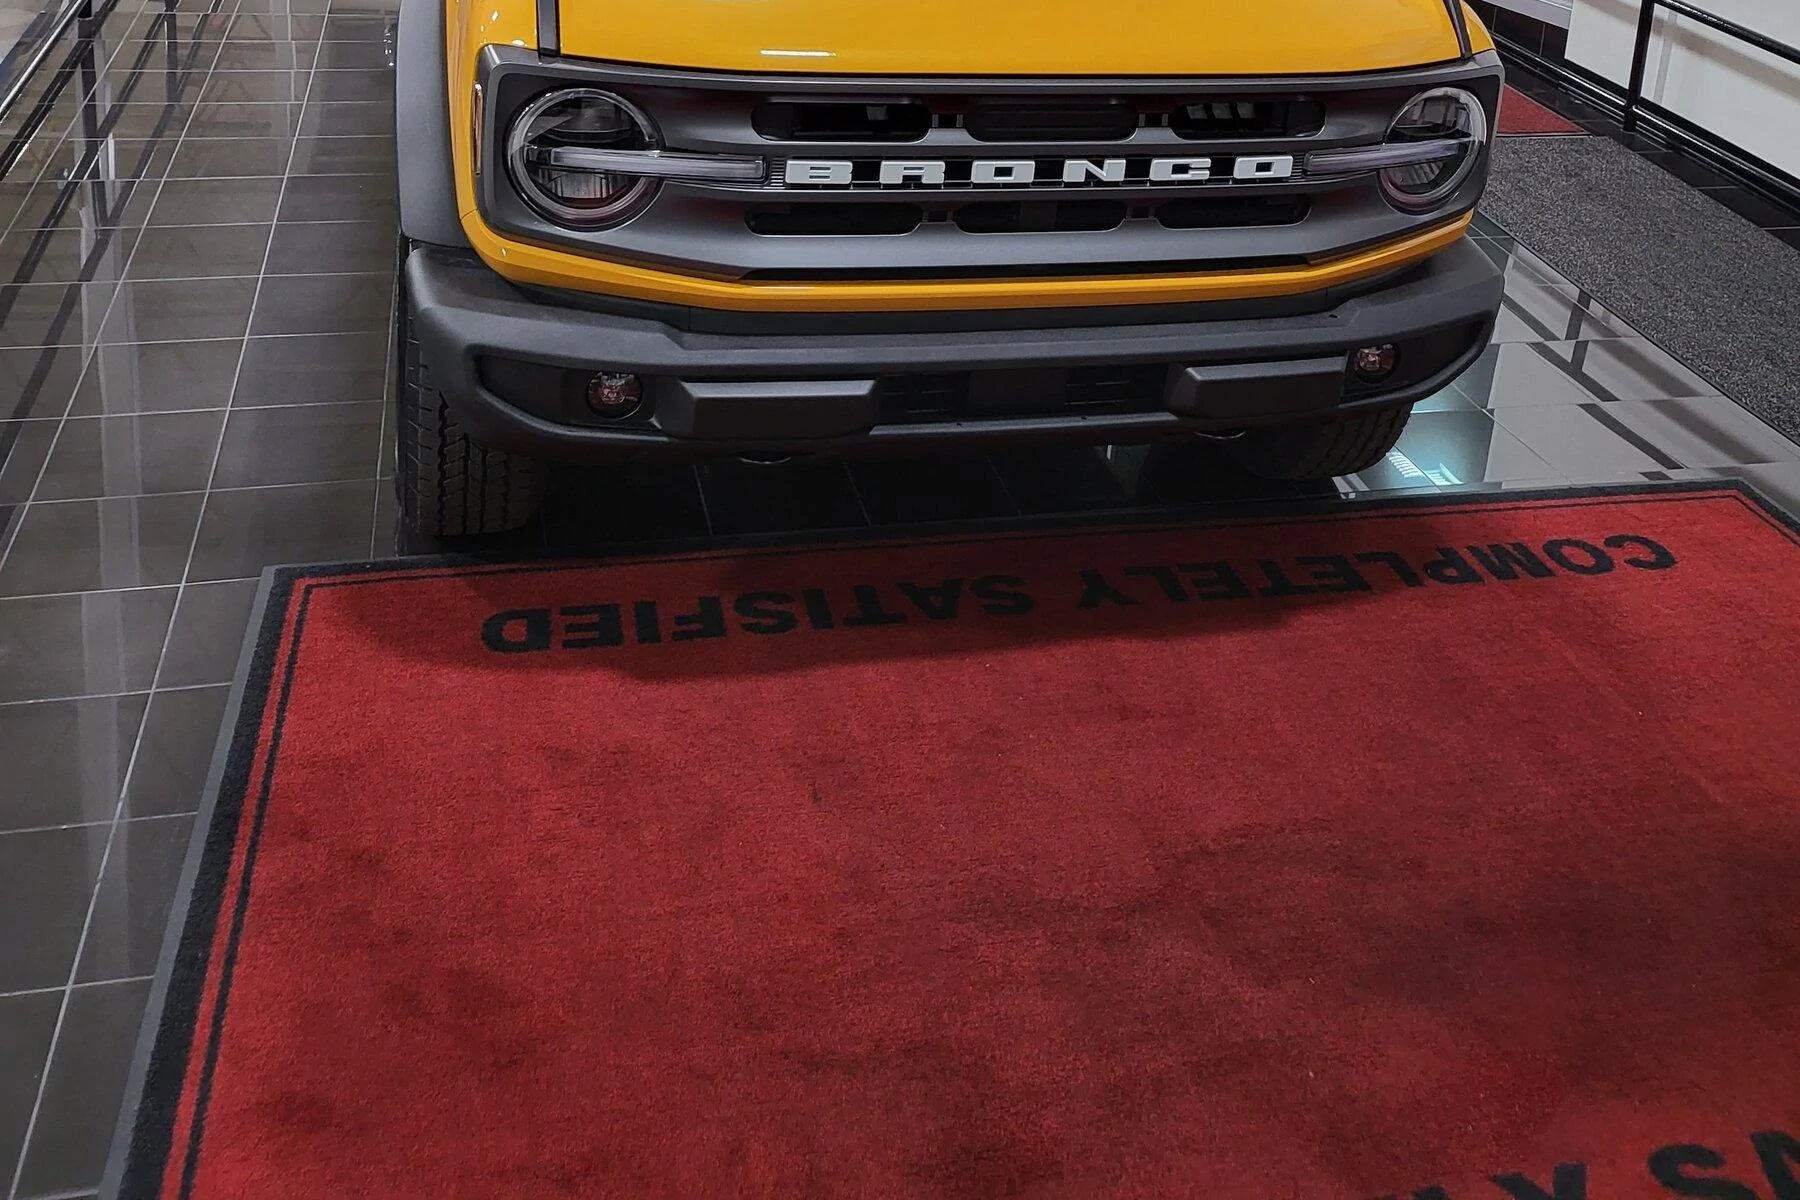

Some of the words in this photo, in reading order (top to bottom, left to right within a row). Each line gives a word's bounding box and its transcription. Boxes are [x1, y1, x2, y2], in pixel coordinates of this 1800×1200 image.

[785, 154, 1294, 185] BRONCO
[1074, 534, 1680, 609] COMPLETELY
[481, 574, 1035, 653] SATISFIED
